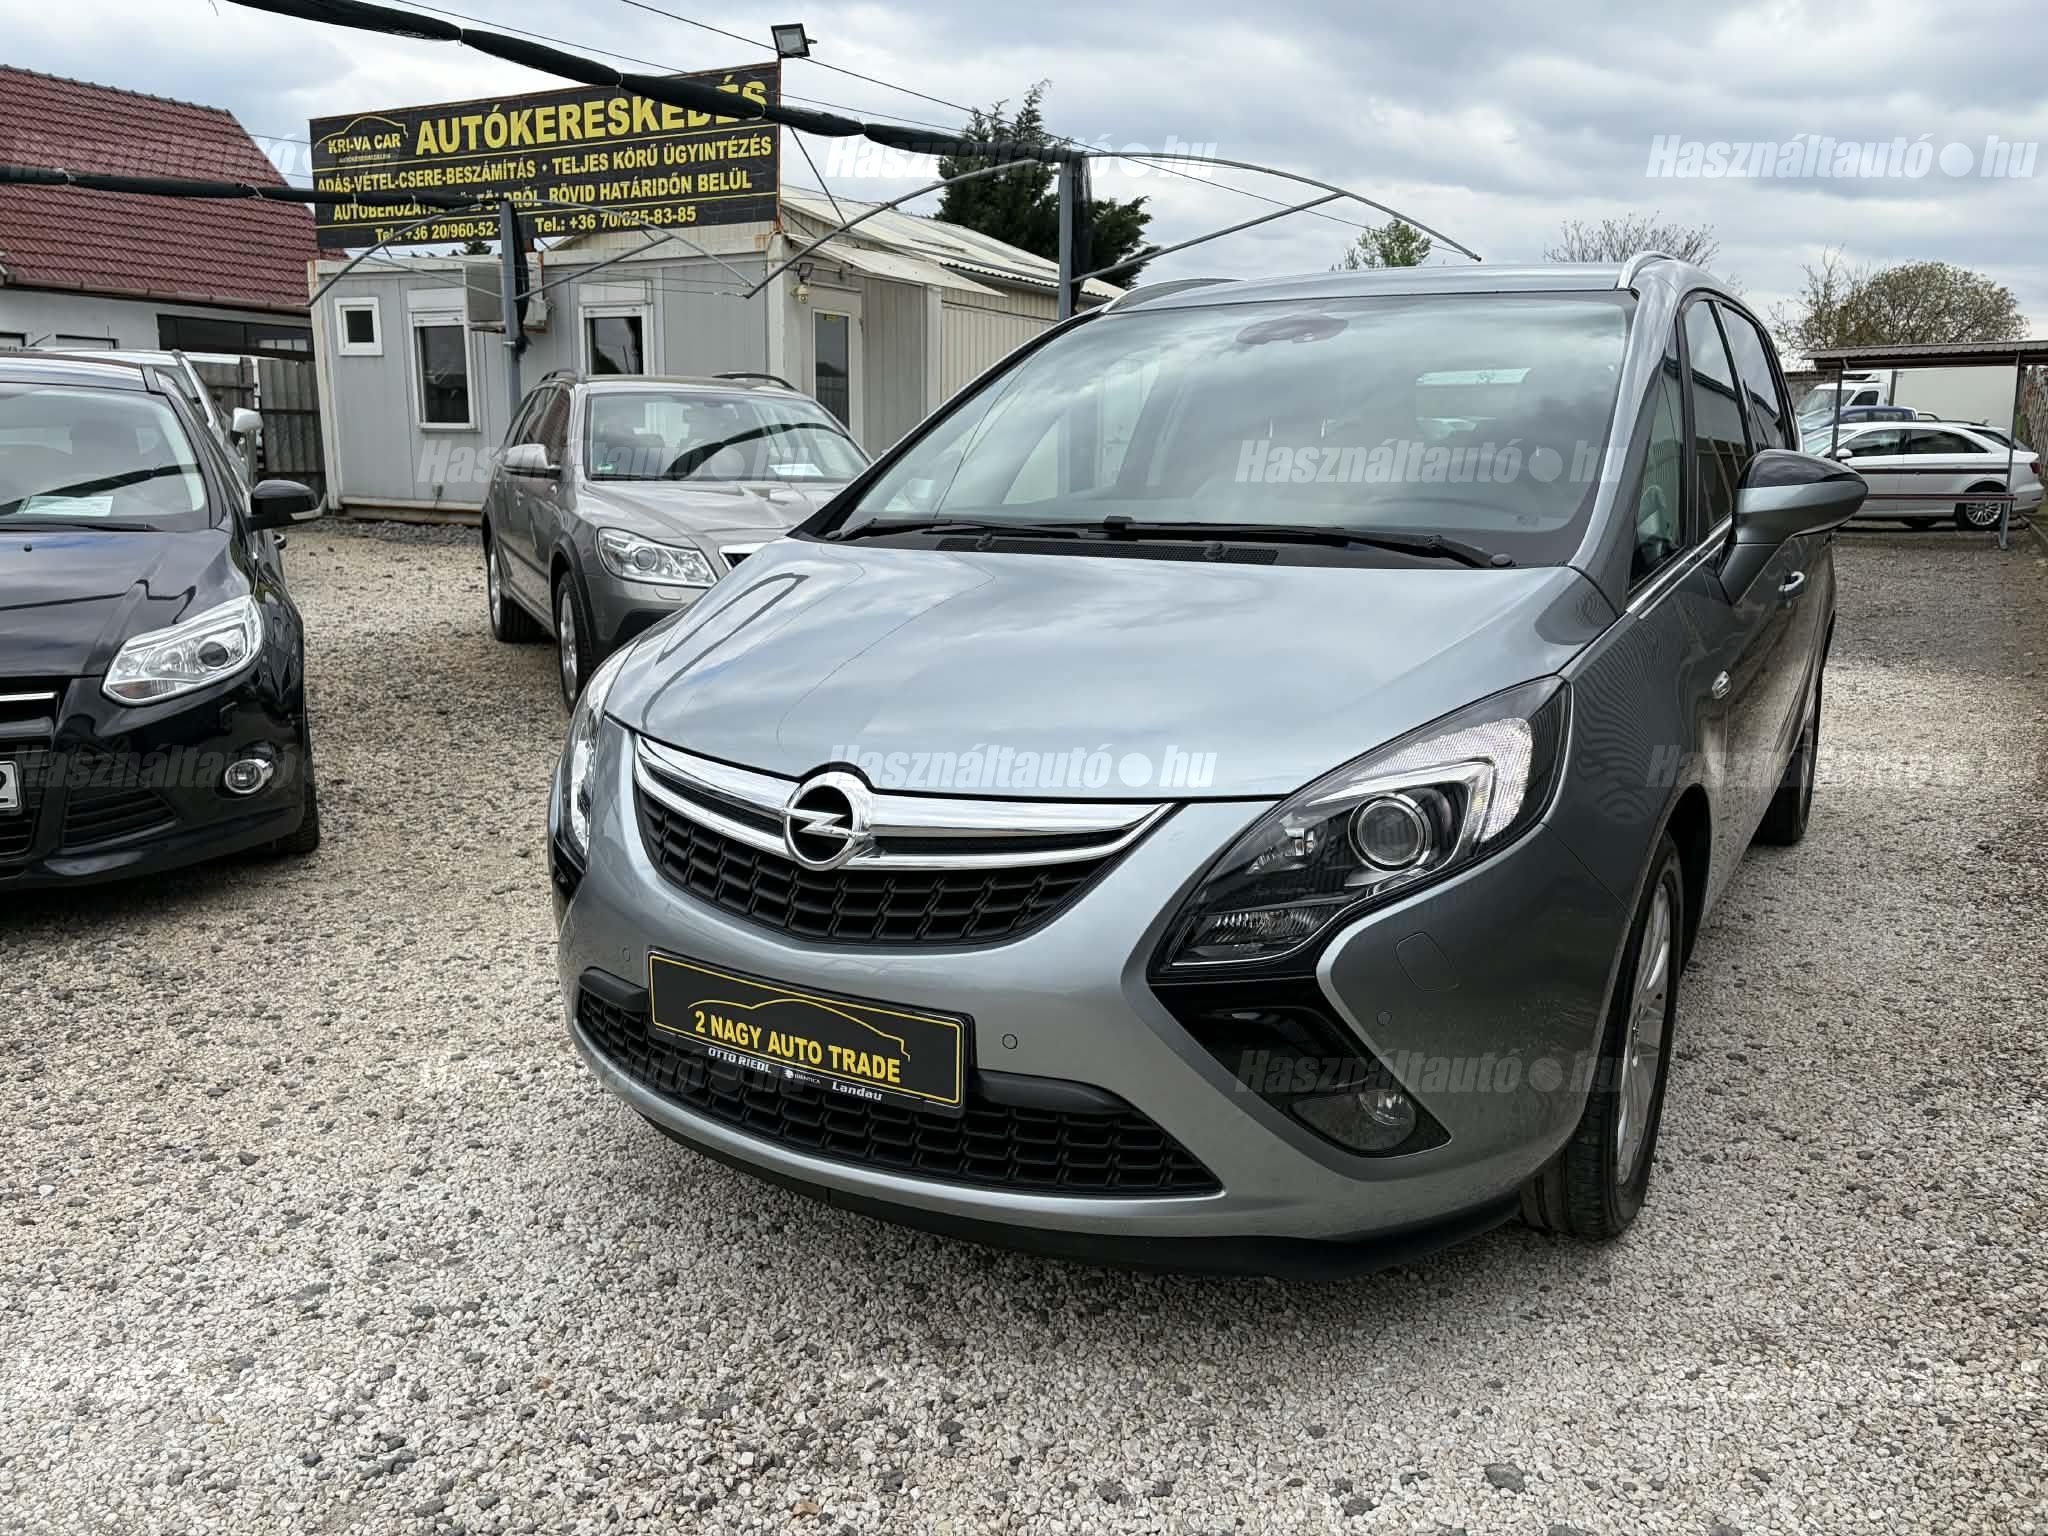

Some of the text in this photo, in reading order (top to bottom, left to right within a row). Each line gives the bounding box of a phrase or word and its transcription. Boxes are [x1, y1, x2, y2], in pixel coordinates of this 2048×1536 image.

[327, 136, 371, 154] KRI-VA
[374, 133, 401, 150] CAR
[551, 152, 609, 176] TELJES
[613, 147, 659, 170] KÖRŰ
[663, 134, 773, 165] ÜGYINTÉZÉS
[549, 182, 595, 205] RÖVID
[599, 172, 693, 201] HATÁRIDŐN
[697, 168, 753, 192] BELÜL
[405, 225, 428, 241] +36
[431, 221, 501, 240] 20/960-52-
[534, 217, 566, 233] Tel.:
[569, 214, 596, 230] +36
[600, 206, 697, 229] 70/625-83-85
[695, 1010, 706, 1034] 2
[710, 1013, 763, 1049] NAGY
[767, 1031, 823, 1065] AUTO
[828, 1045, 901, 1083] TRADE
[708, 1047, 737, 1065] OTTO
[738, 1055, 772, 1073] RIEDL
[831, 1080, 883, 1102] Landau
